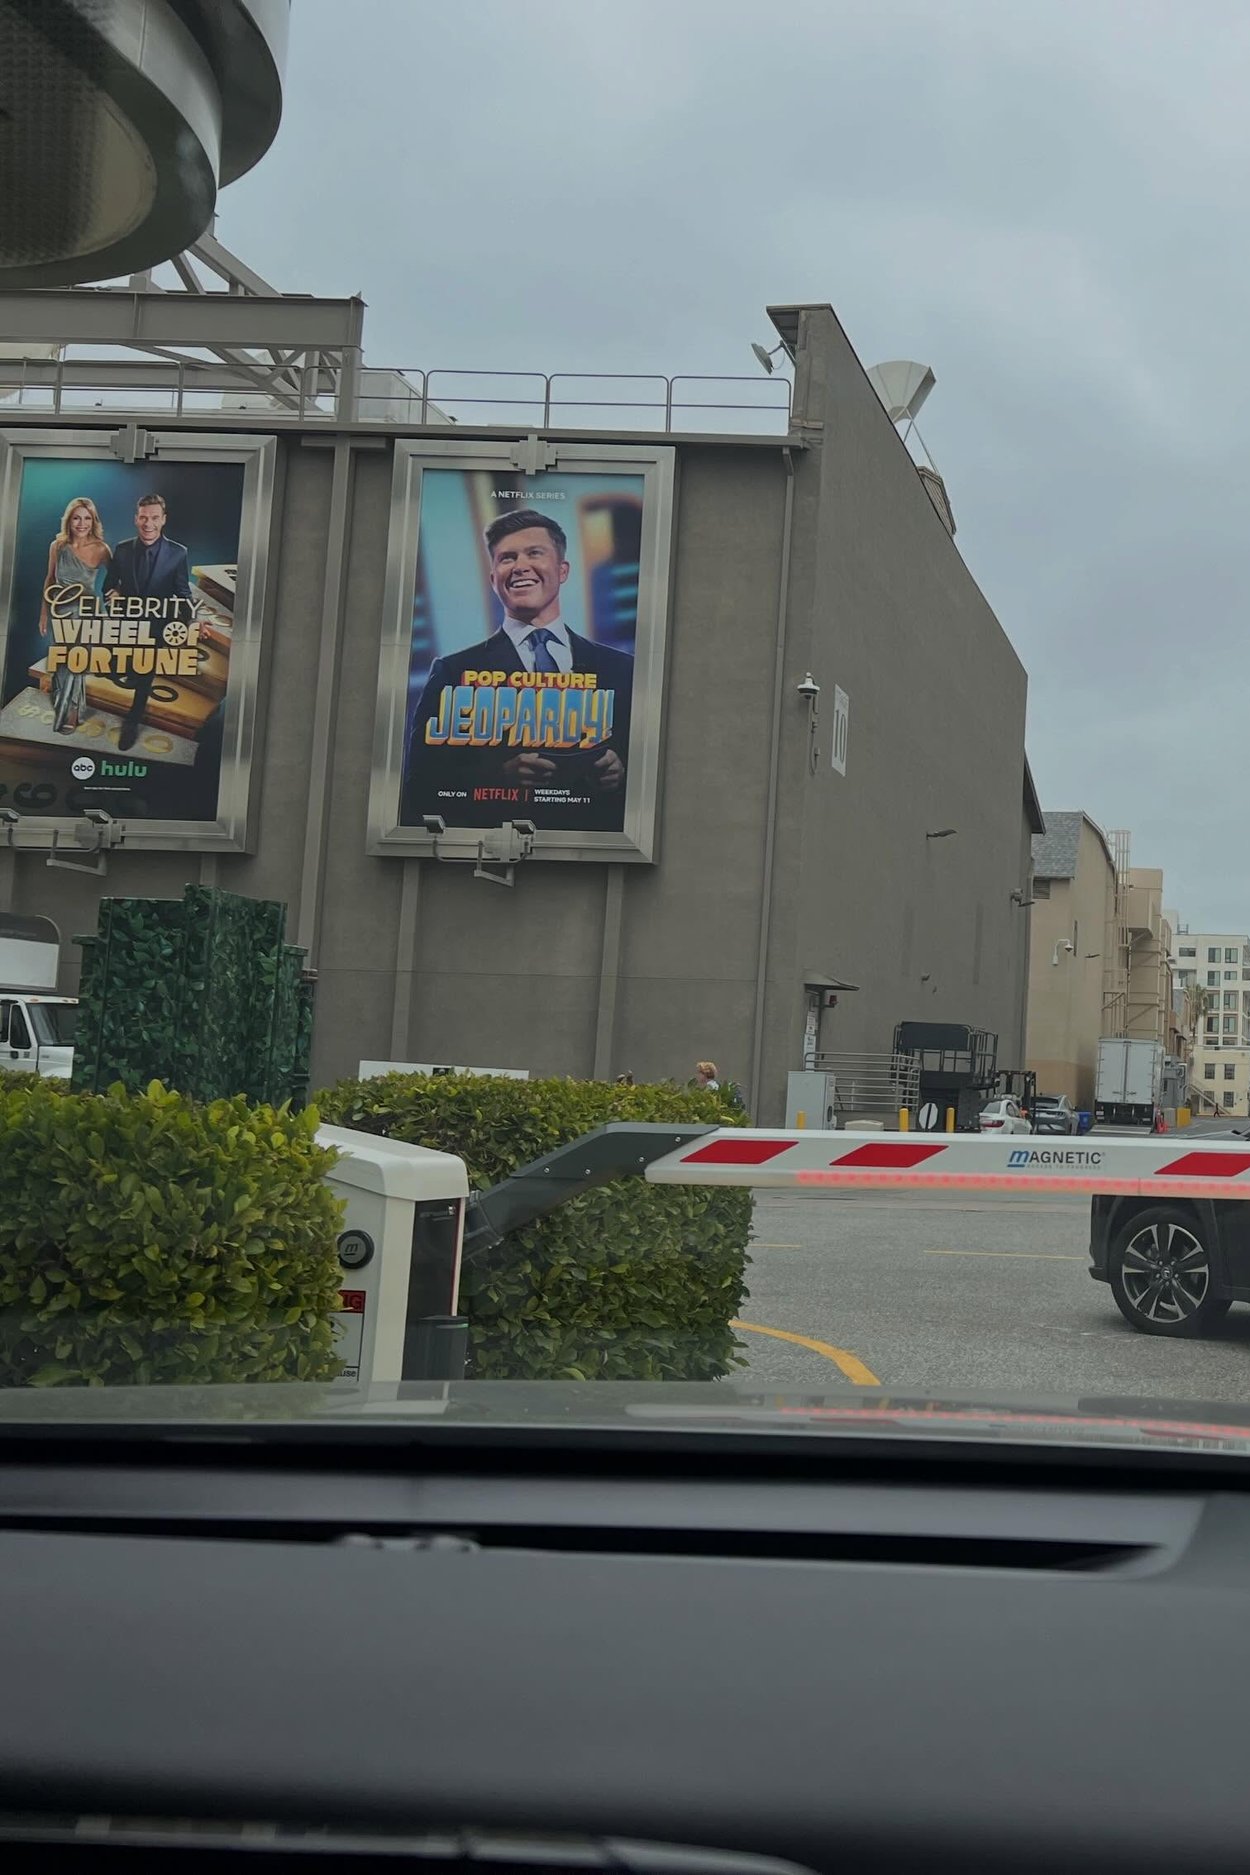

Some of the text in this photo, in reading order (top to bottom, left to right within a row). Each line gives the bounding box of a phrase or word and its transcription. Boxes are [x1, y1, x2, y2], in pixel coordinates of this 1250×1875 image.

[498, 491, 534, 499] NETFLIX
[536, 492, 566, 500] SERIES
[44, 583, 204, 619] CELEBRITY
[51, 619, 156, 646] WHEEL
[48, 645, 200, 676] FORTUNE
[461, 670, 598, 689] POP CULTURE
[425, 685, 615, 749] JEOPARDY!
[73, 759, 94, 773] abc
[101, 760, 148, 778] hulu
[437, 790, 456, 798] ONLY
[473, 788, 519, 801] NETFLIX
